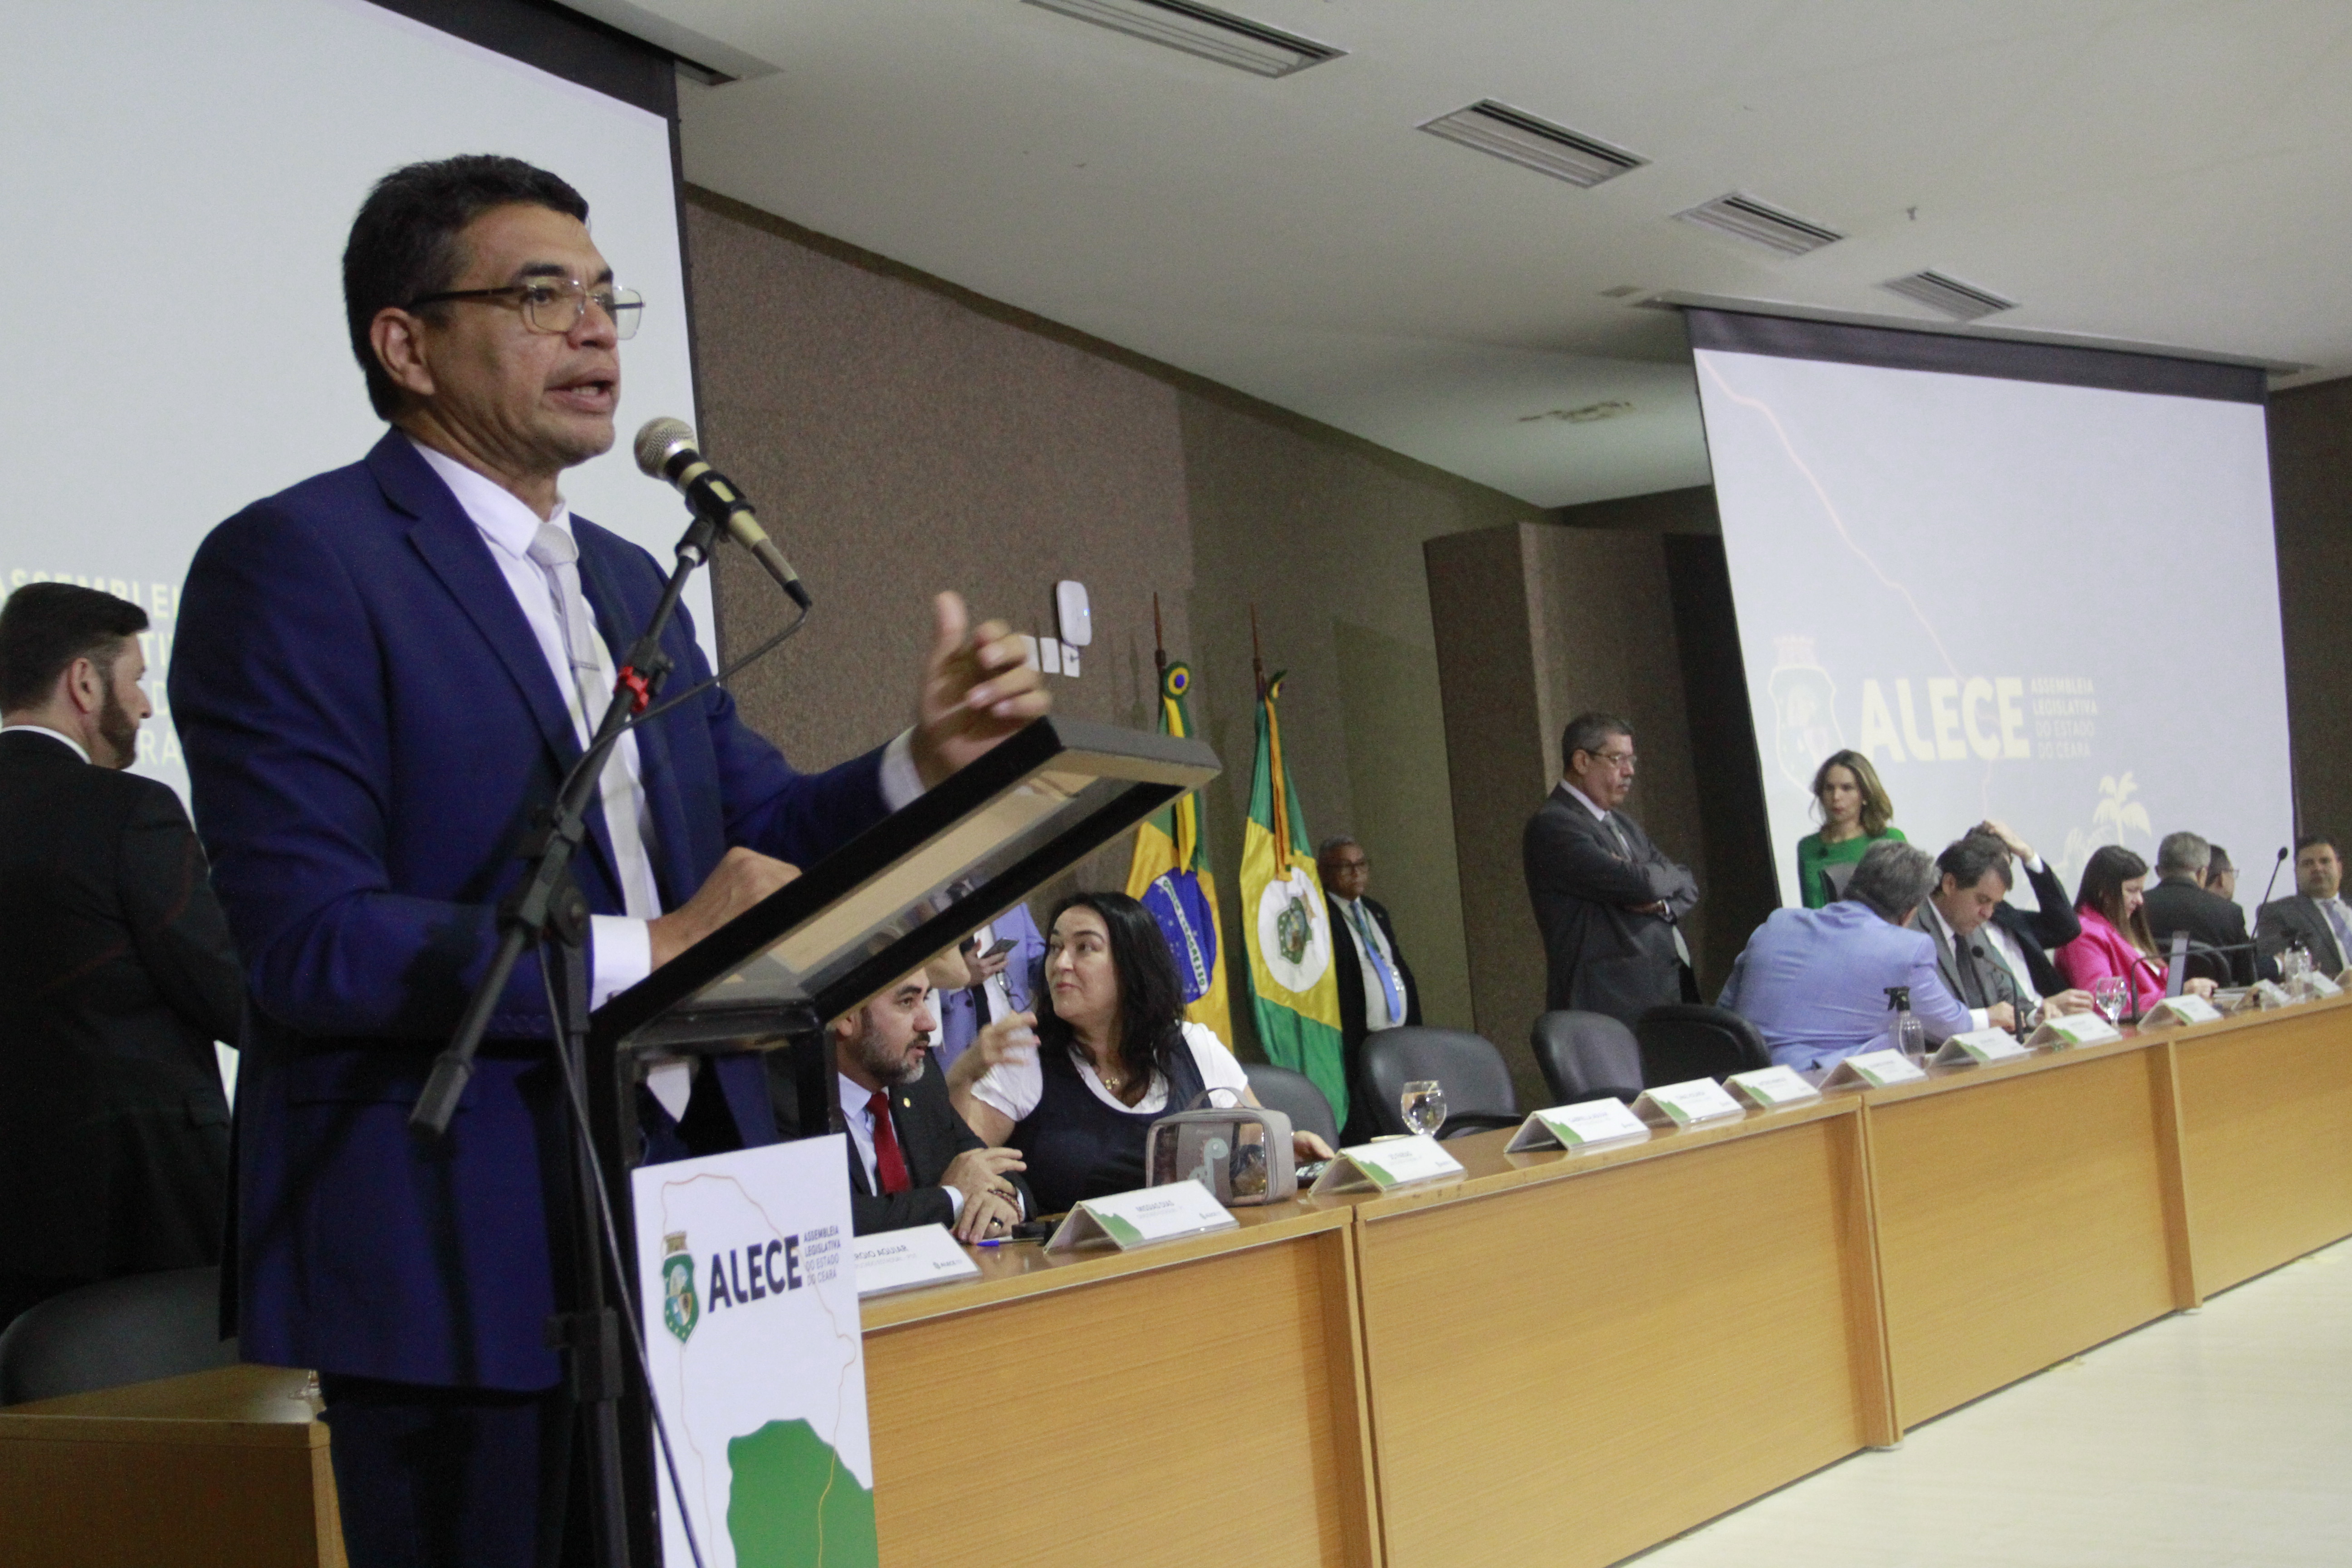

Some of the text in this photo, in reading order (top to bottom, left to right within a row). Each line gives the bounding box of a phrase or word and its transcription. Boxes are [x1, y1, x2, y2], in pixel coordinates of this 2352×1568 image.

[1861, 677, 2030, 762] ALECE
[804, 1225, 839, 1242] ASSEMBLEIA
[804, 1239, 841, 1257] LEGISLATIVA
[816, 1253, 839, 1269] ESTADO
[708, 1234, 803, 1314] ALECE
